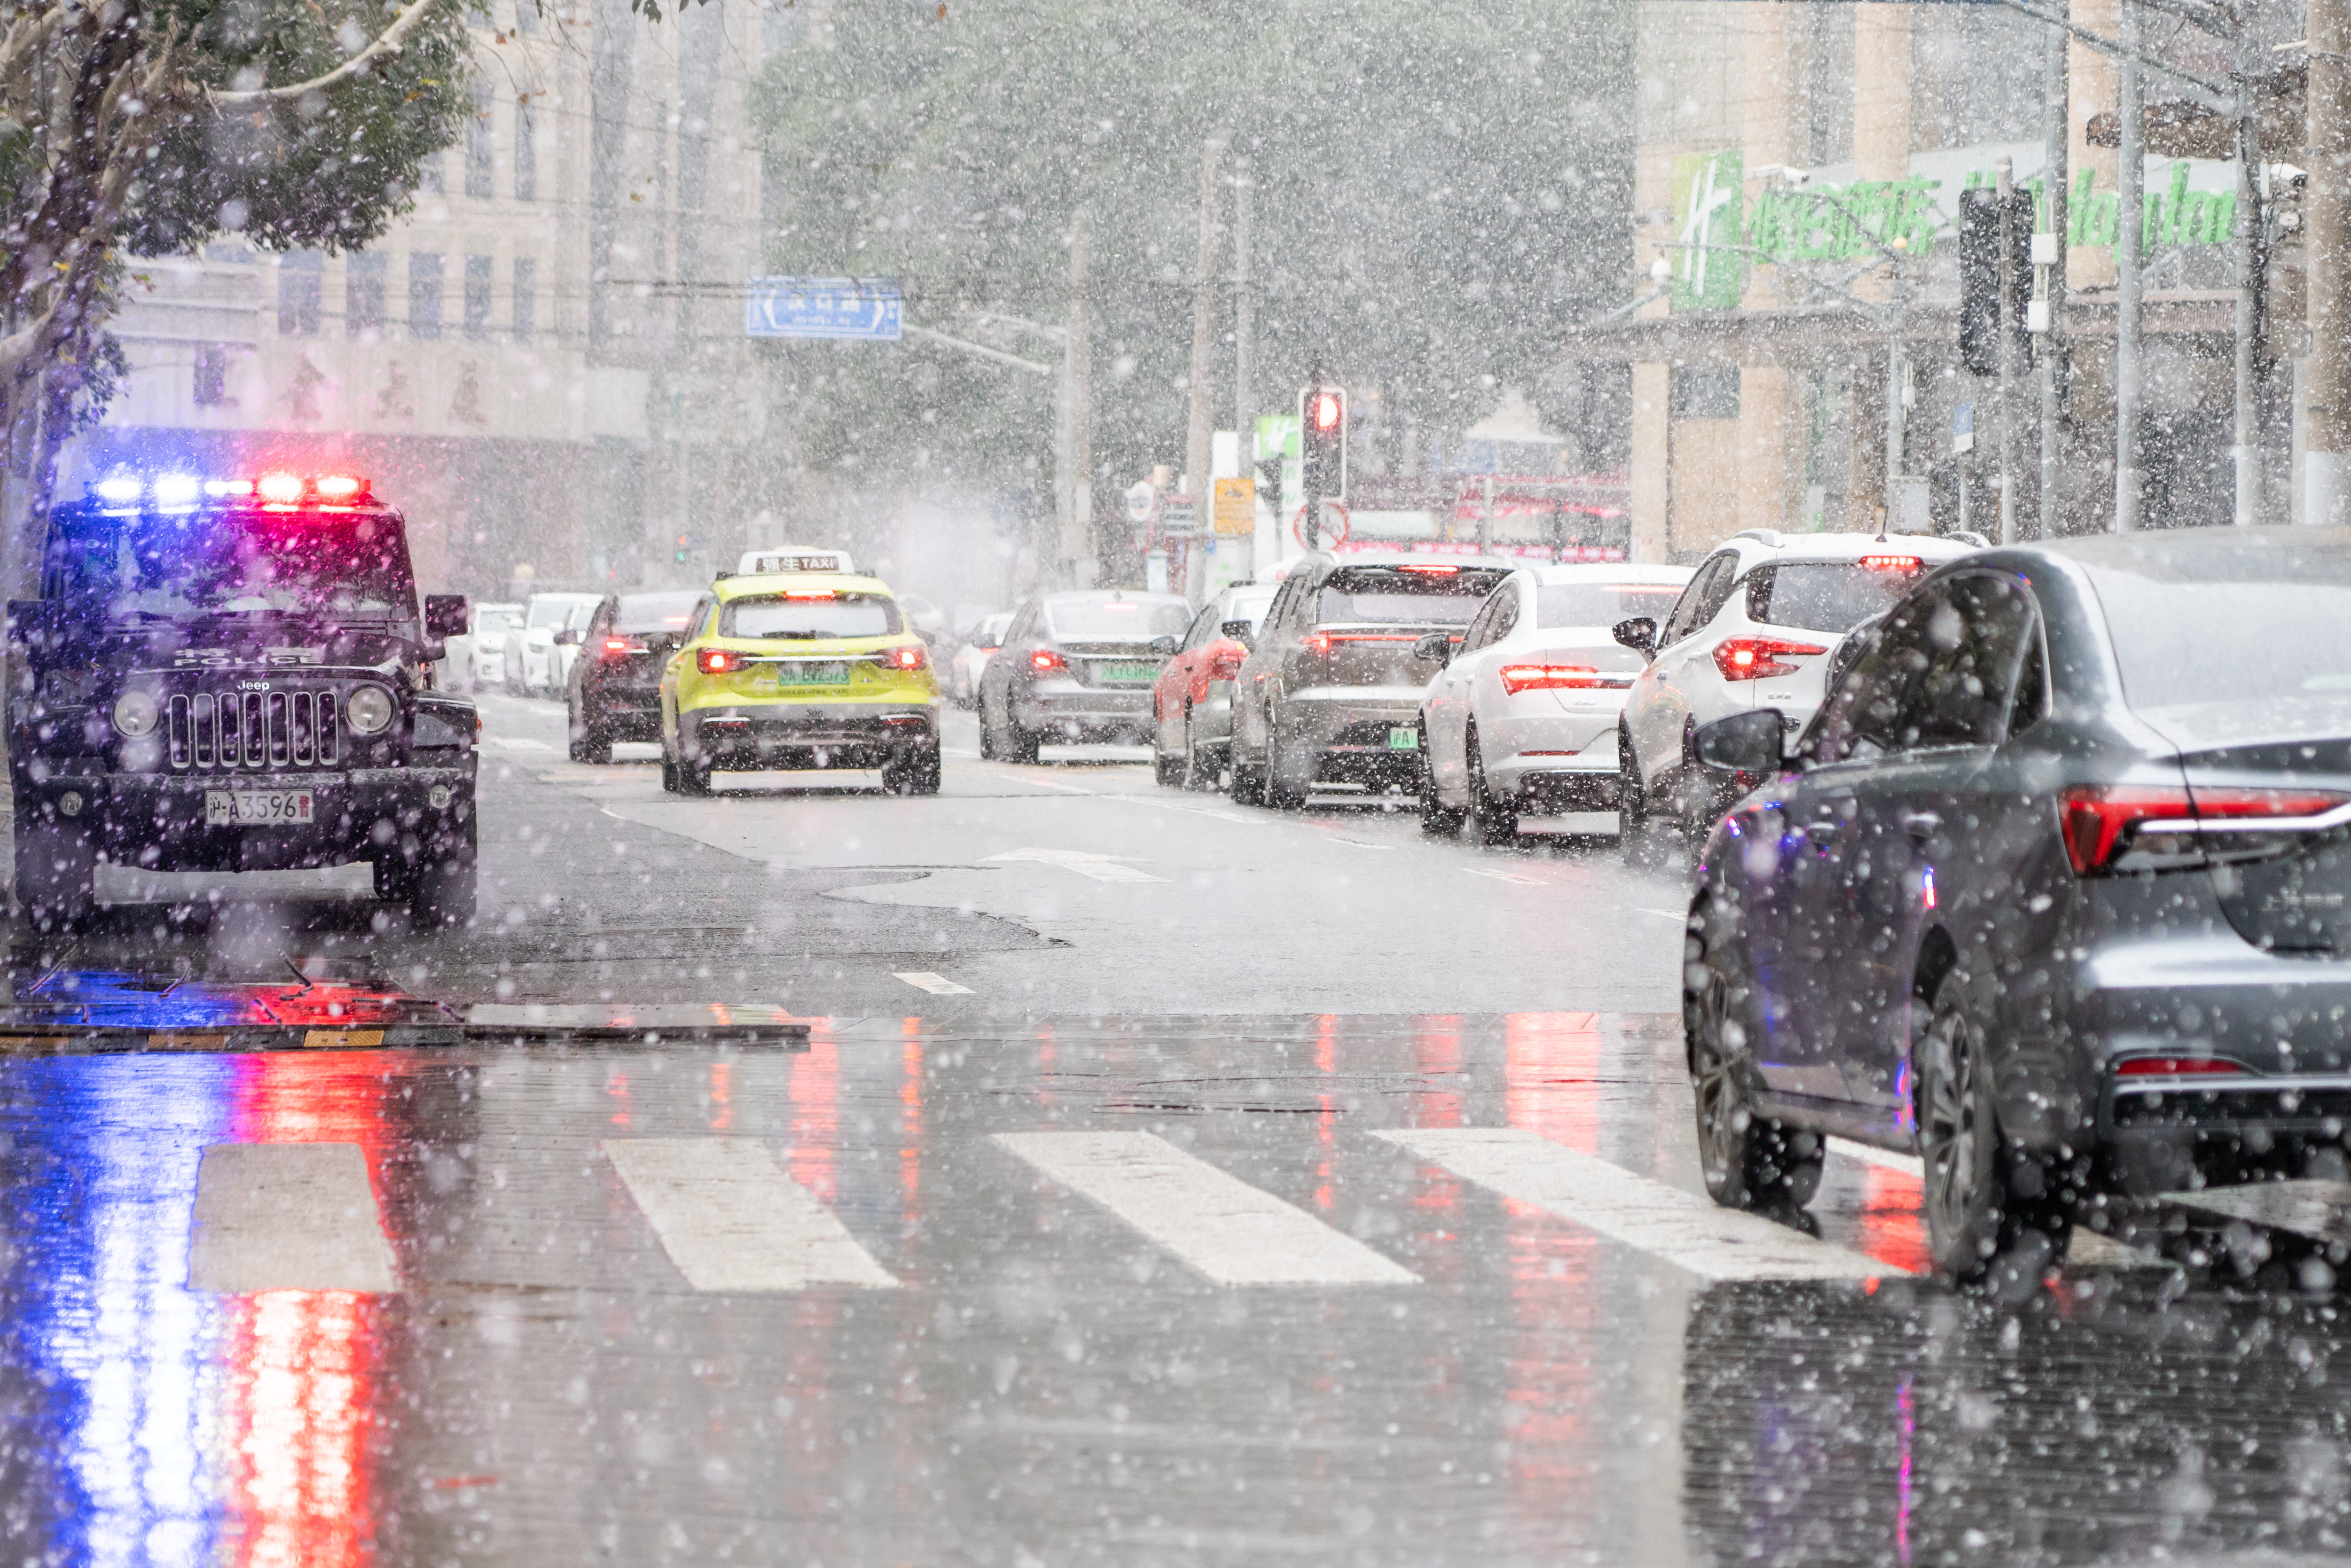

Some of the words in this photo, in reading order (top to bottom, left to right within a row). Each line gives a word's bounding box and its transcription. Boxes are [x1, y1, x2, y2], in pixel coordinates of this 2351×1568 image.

[801, 557, 835, 569] TAXI
[174, 656, 323, 666] POLICE
[237, 680, 270, 691] Jeep
